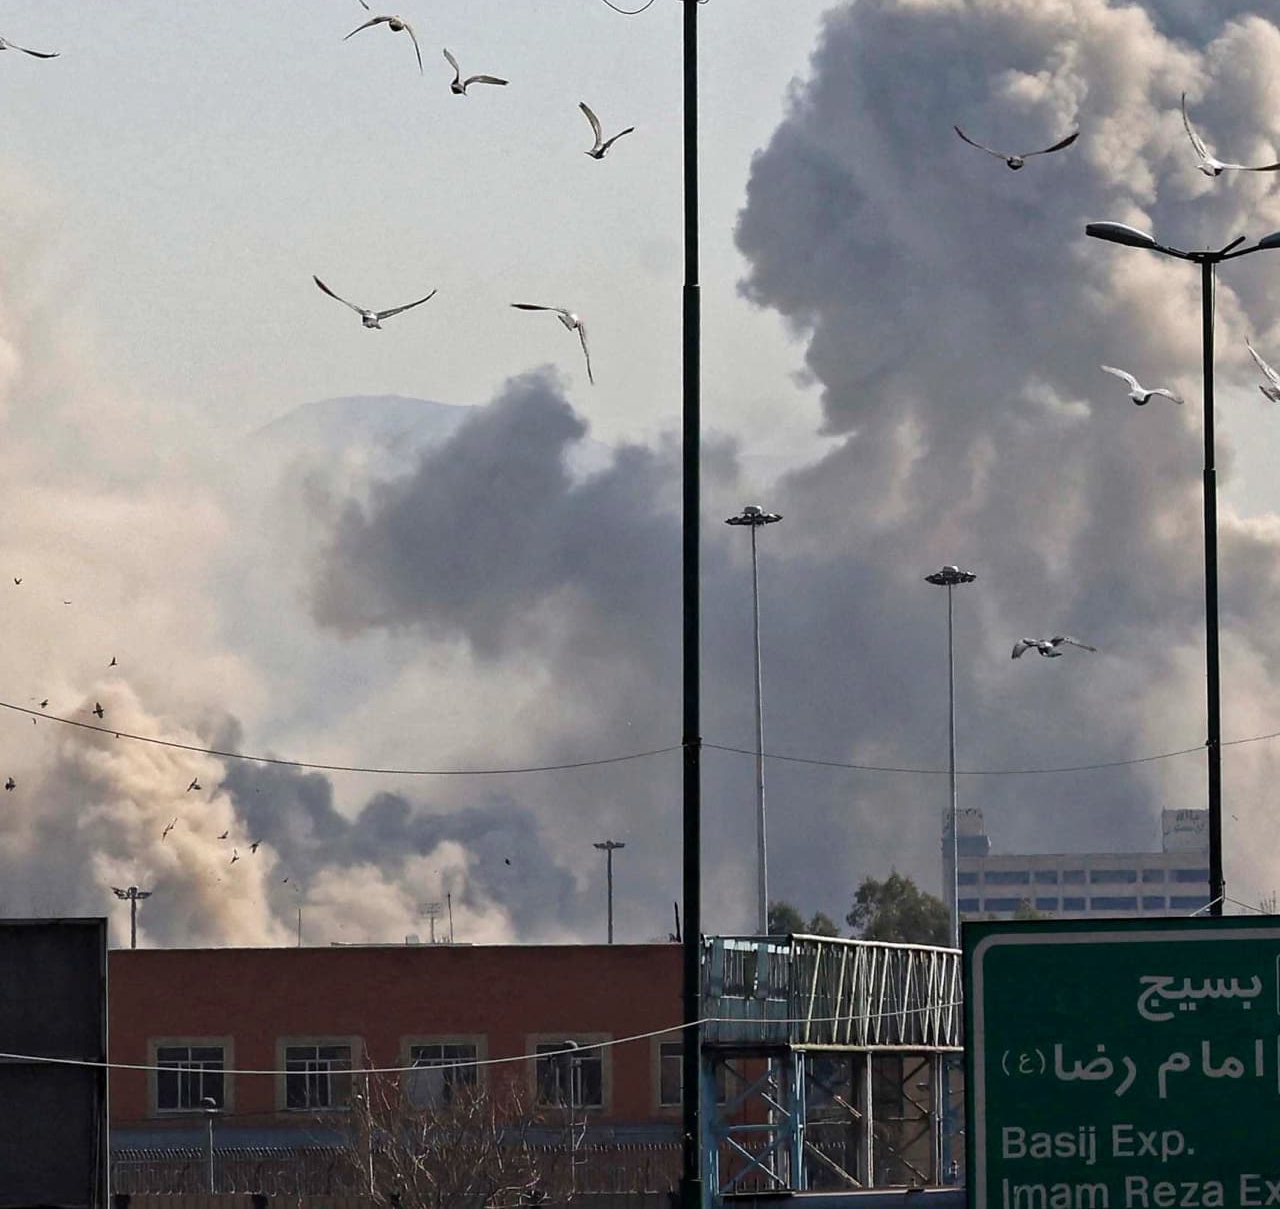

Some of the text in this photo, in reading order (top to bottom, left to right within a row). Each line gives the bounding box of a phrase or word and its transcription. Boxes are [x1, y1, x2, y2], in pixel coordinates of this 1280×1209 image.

[1138, 973, 1263, 1021] بسیج
[1053, 1044, 1137, 1096] رضا
[1157, 1038, 1264, 1098] امام
[1002, 1125, 1195, 1165] Basij Exp.
[1002, 1178, 1109, 1209] Imam
[1125, 1176, 1224, 1207] Reza
